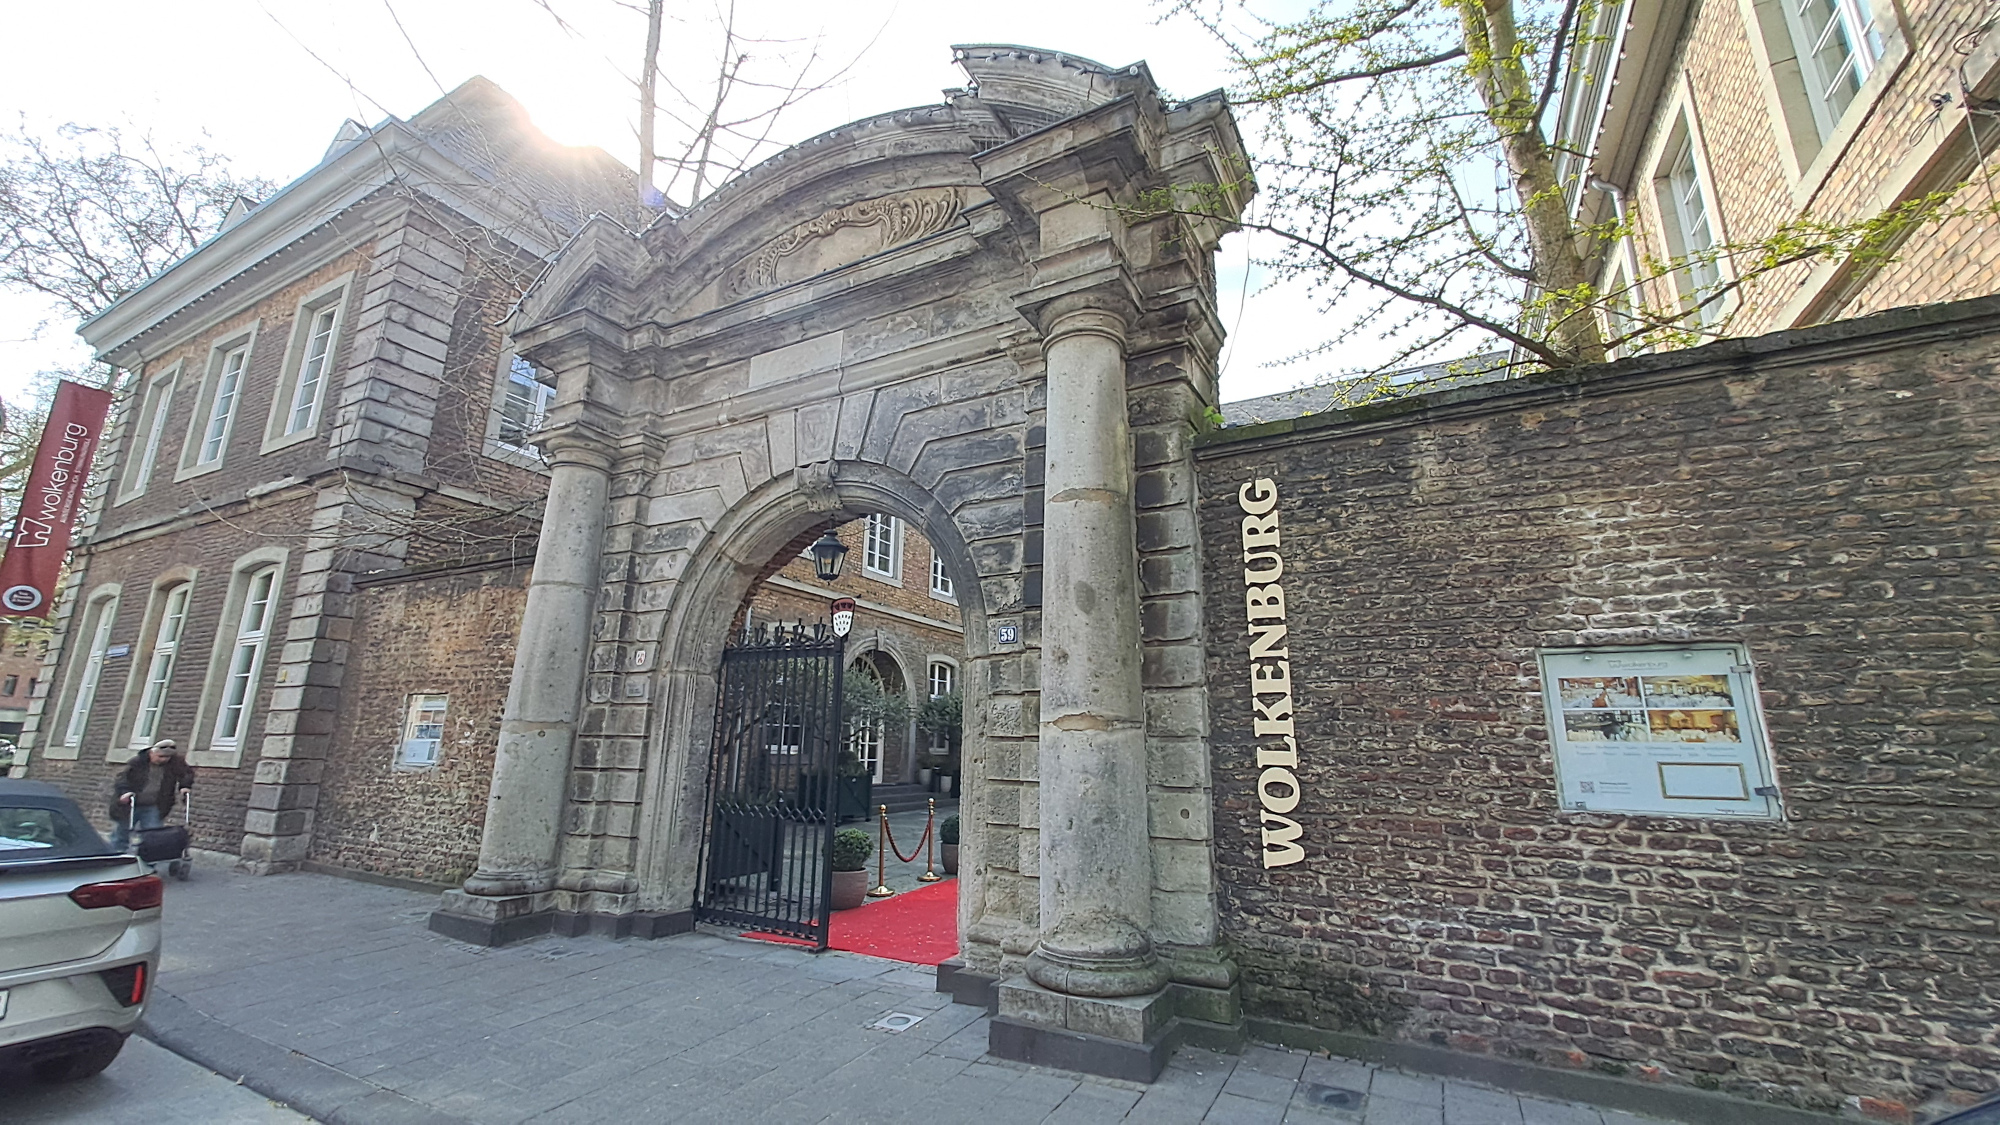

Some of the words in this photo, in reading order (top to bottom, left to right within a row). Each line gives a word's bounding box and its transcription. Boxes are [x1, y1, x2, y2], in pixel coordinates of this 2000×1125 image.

[38, 422, 88, 521] wolkenburg
[1000, 628, 1015, 642] 59
[1239, 477, 1305, 870] WOLKENBURG
